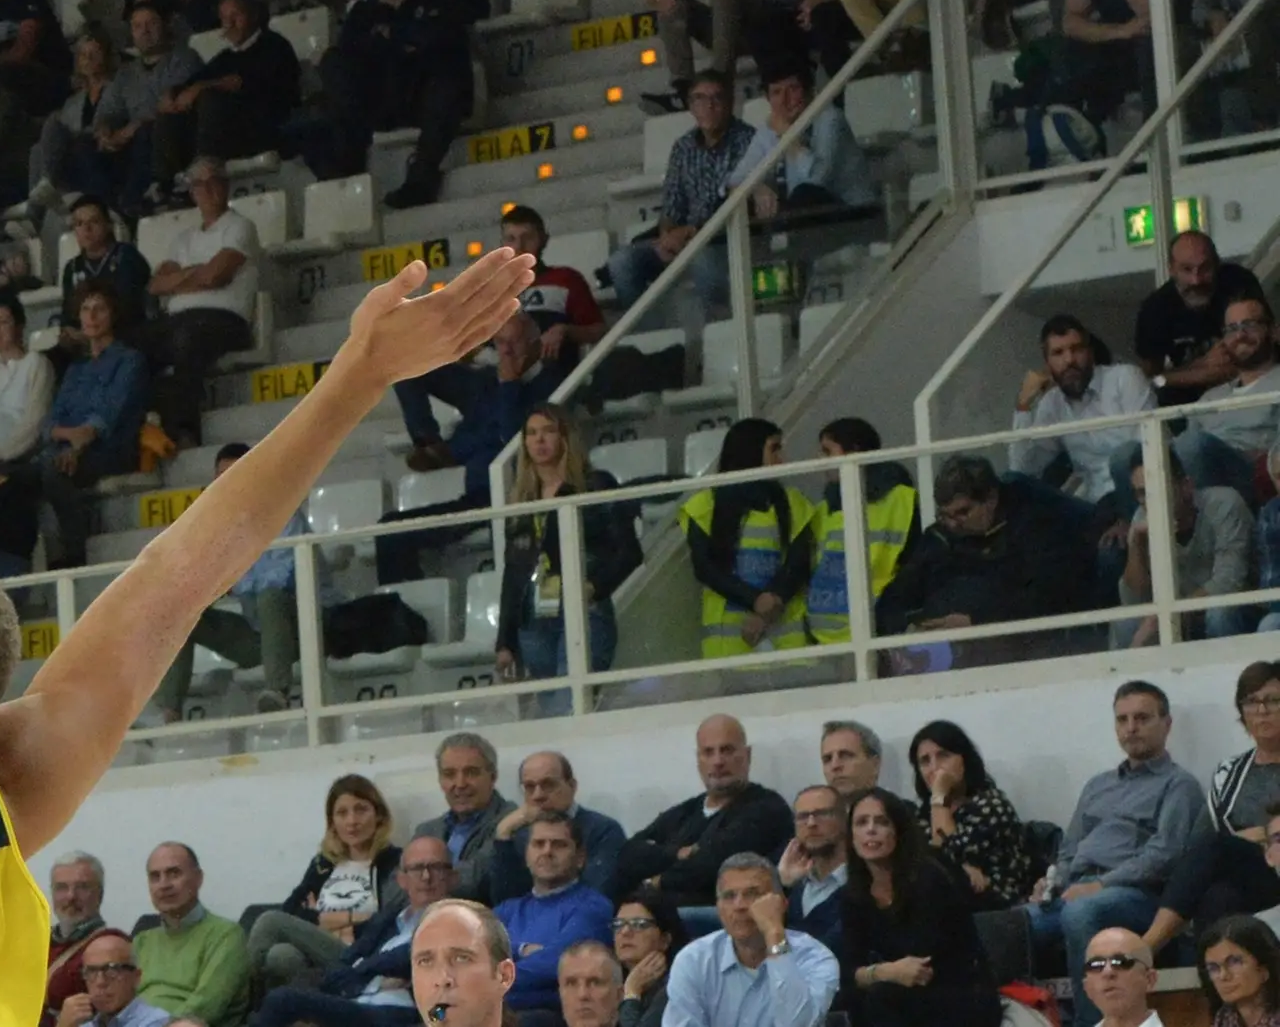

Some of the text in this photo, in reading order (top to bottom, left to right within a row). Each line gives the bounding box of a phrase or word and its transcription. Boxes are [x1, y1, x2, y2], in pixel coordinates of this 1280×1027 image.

[577, 15, 654, 50] FILA 8
[475, 126, 549, 163] FILA 7
[429, 242, 445, 269] 6
[259, 369, 310, 401] FILA
